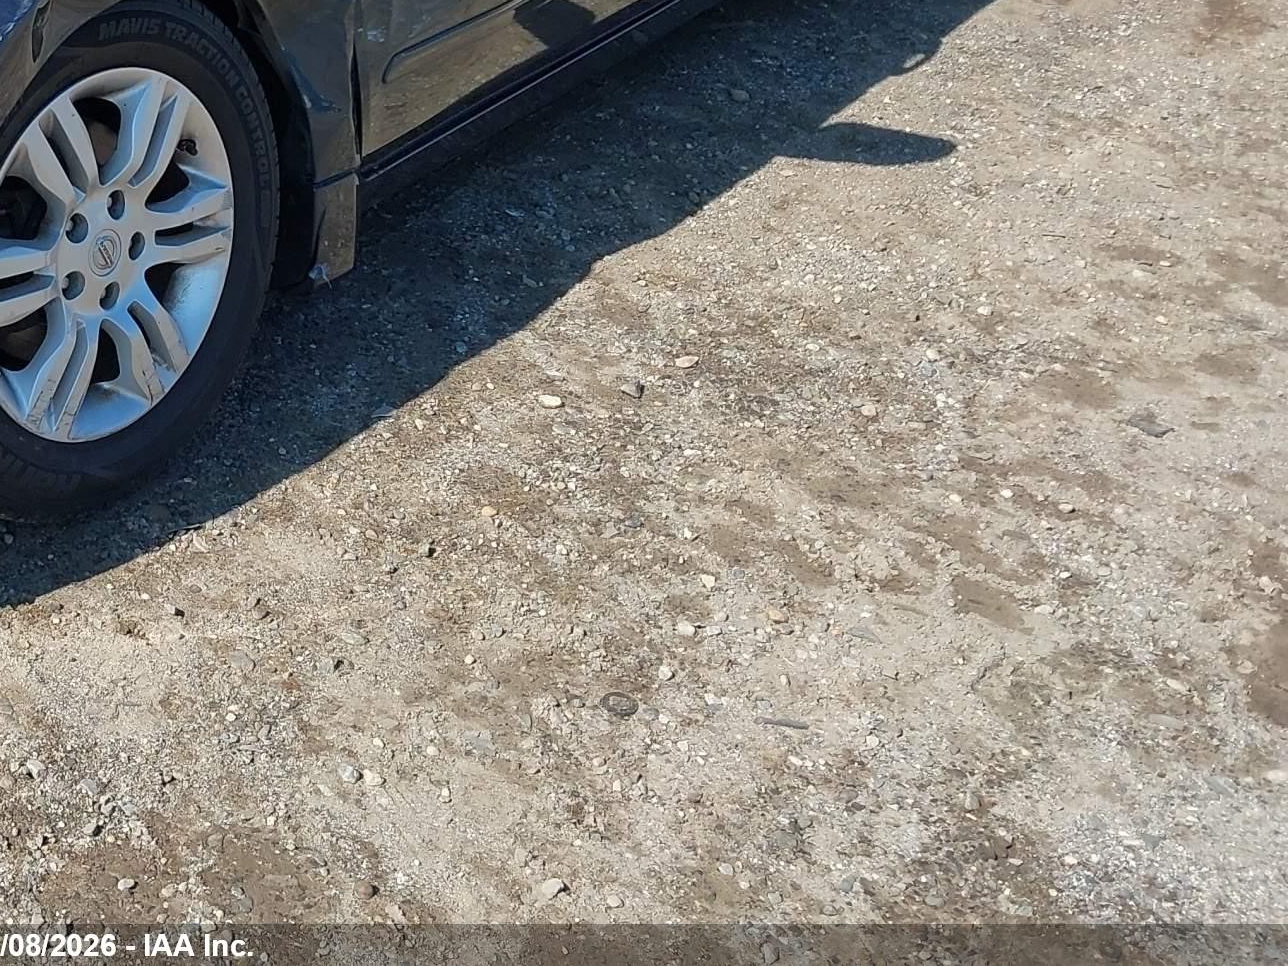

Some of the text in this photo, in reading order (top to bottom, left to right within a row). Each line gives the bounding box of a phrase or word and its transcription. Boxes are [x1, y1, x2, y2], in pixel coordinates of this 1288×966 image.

[97, 15, 272, 187] MAVIS TRACTION CONTROL
